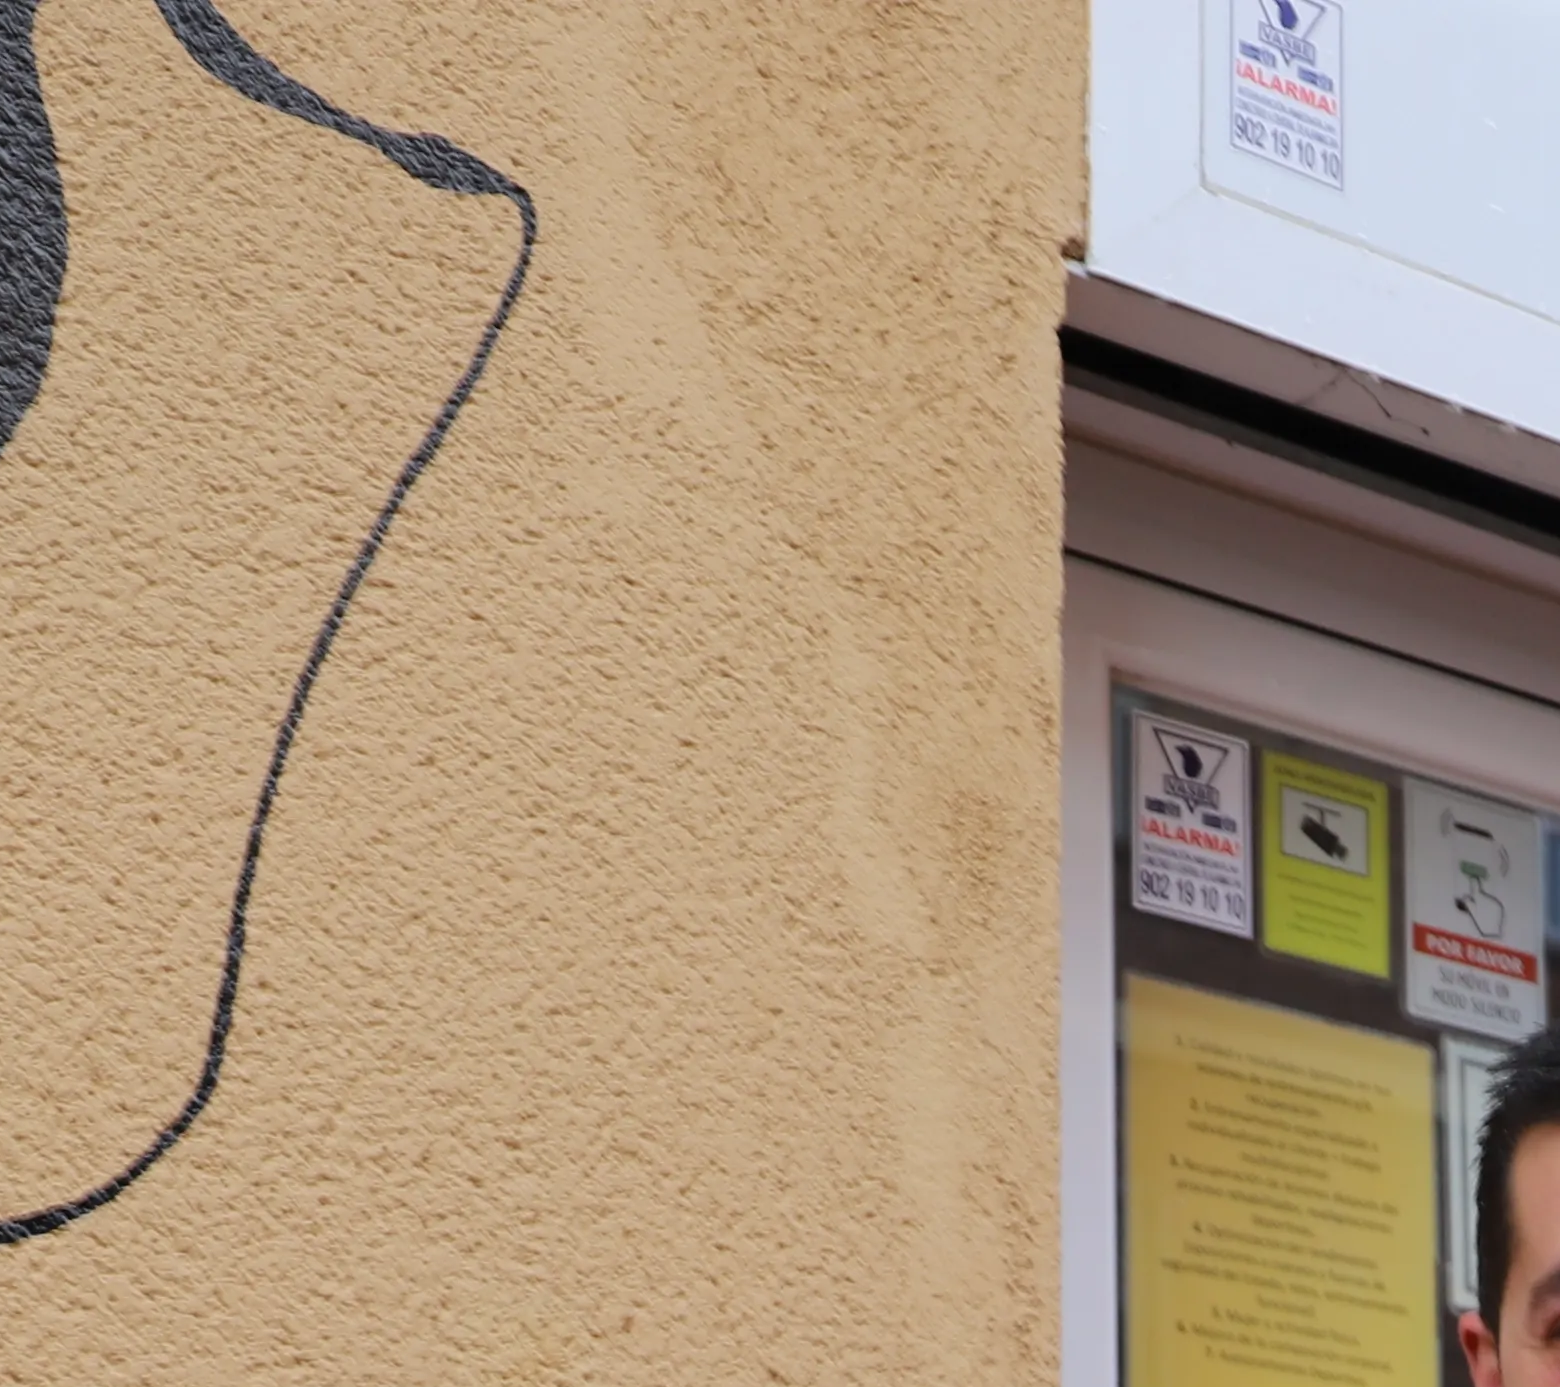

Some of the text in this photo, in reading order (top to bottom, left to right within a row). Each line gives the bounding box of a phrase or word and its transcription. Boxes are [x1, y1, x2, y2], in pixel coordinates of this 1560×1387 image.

[1236, 58, 1337, 117] ¡ALARMA!
[1235, 111, 1267, 150] 902
[1271, 128, 1291, 159] 19
[1295, 138, 1316, 170] 10
[1321, 149, 1341, 180] 10
[1140, 869, 1170, 900] 902
[1176, 878, 1195, 906] 19
[1200, 885, 1219, 913] 10
[1225, 891, 1245, 920] 10
[1425, 932, 1526, 978] POR FAVOR
